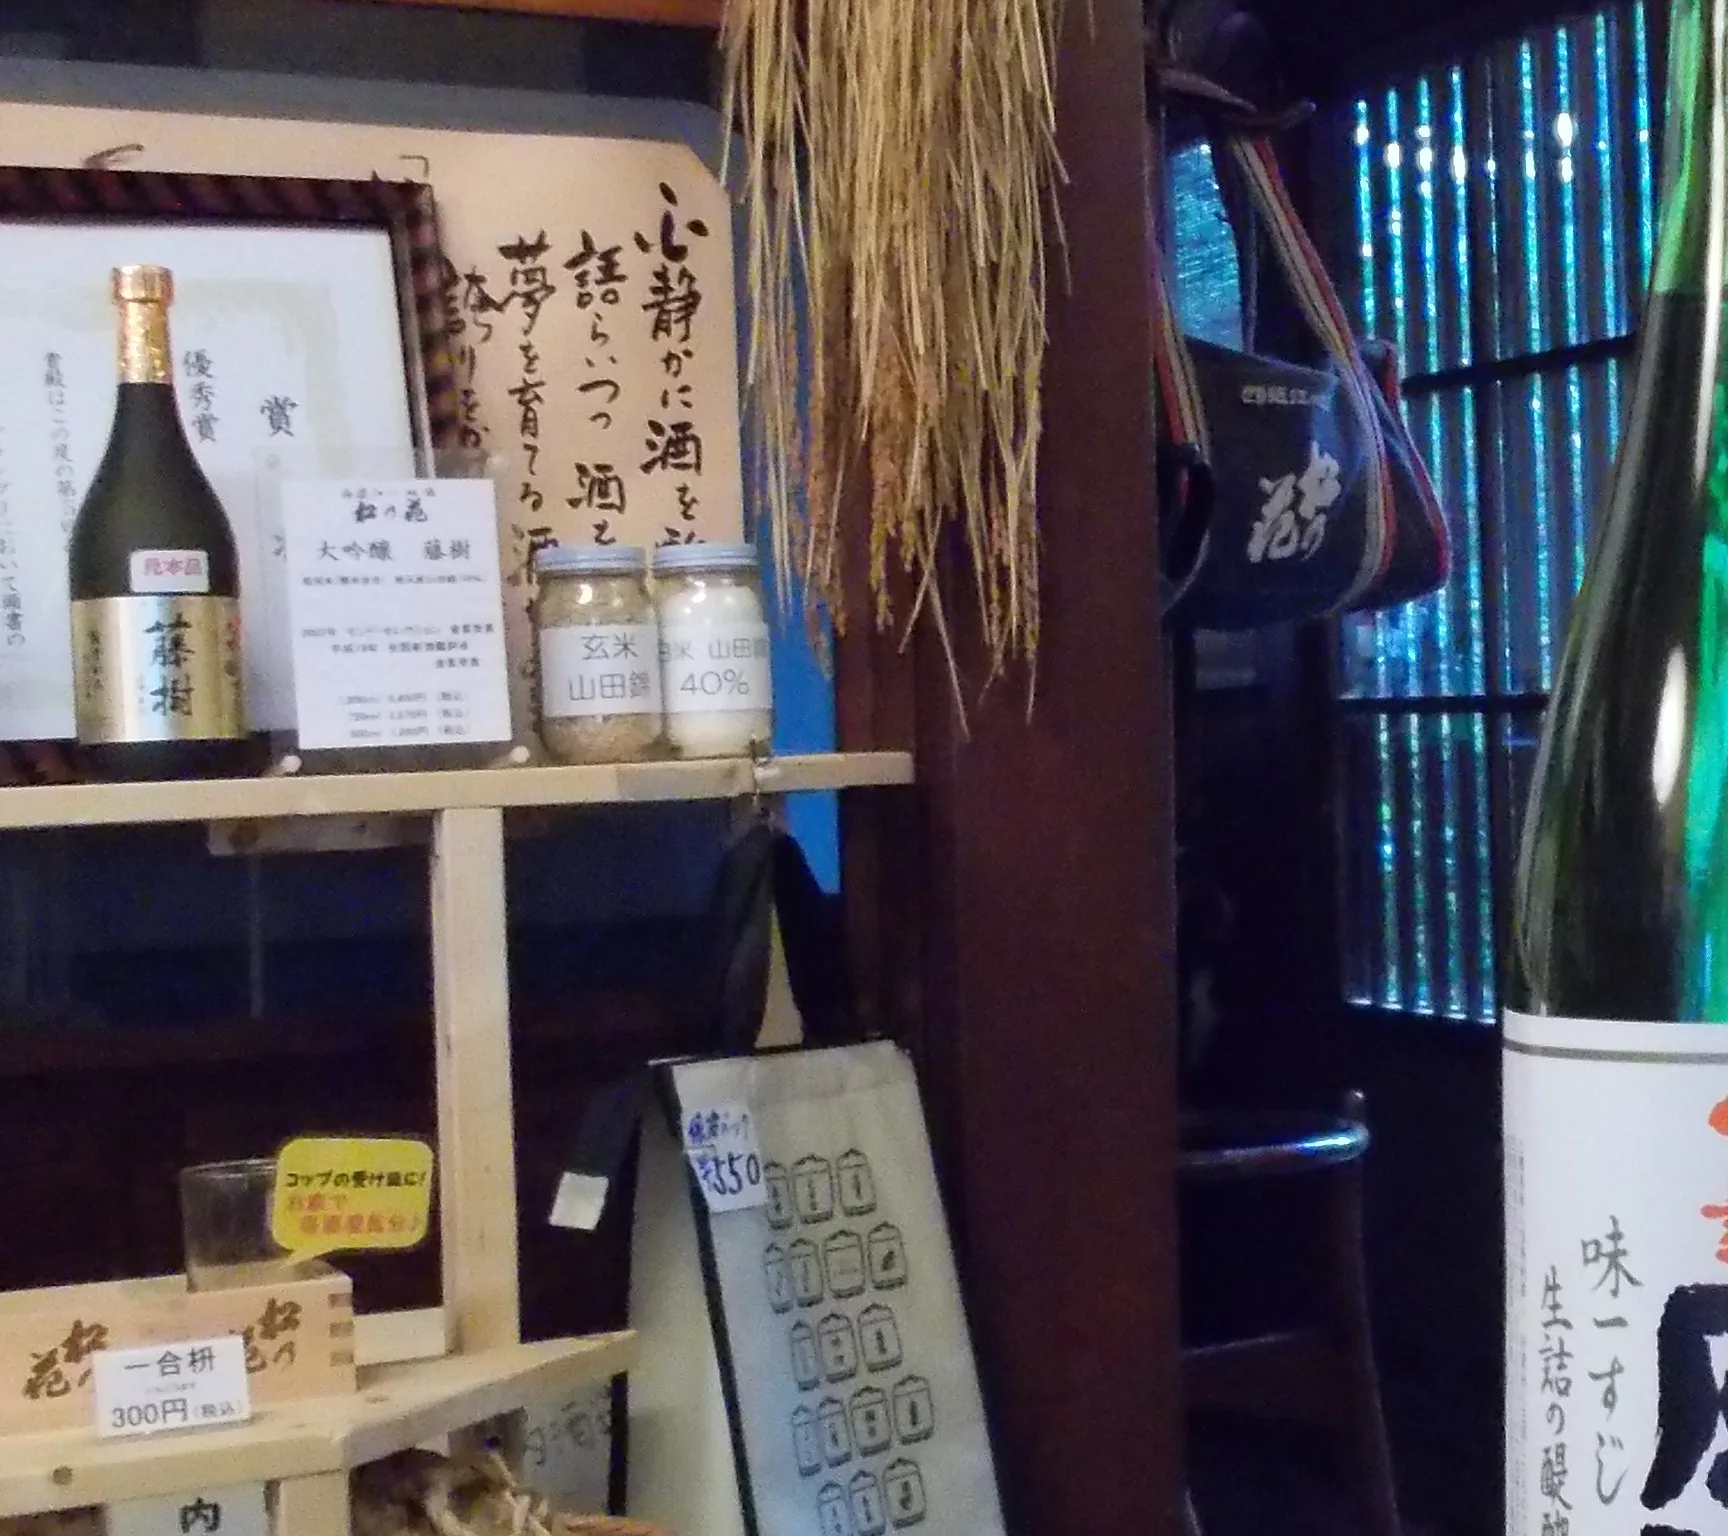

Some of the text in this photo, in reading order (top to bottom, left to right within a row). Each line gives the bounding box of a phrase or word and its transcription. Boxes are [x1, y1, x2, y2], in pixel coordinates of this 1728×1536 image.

[183, 349, 220, 443] 優秀賞
[634, 182, 709, 547] 心静かに酒を
[581, 632, 638, 660] 玄米
[680, 668, 749, 696] 40%
[1580, 1215, 1643, 1505] 味一すじ
